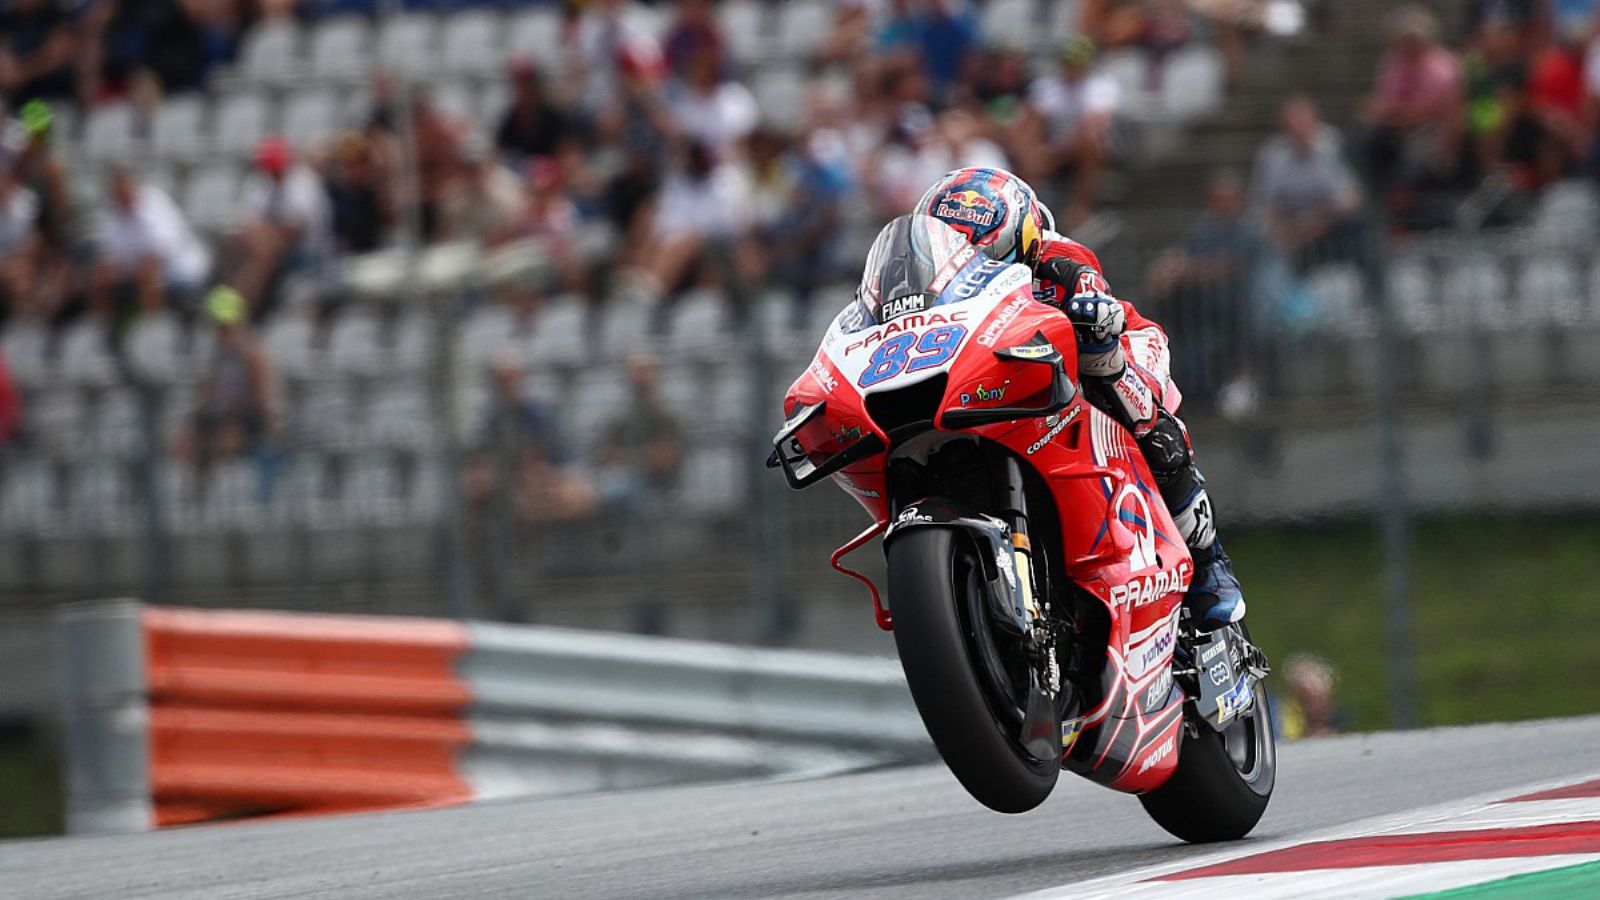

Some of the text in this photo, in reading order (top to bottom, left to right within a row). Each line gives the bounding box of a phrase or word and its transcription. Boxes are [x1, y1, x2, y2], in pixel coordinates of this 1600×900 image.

[937, 204, 994, 226] Red Bull
[953, 259, 1006, 298] OCTO
[882, 293, 926, 321] FIAMM
[983, 295, 1030, 338] PRAMAC
[845, 311, 969, 356] PRAMAC
[857, 323, 968, 389] 89
[1116, 379, 1148, 418] PRAMAC
[1027, 404, 1081, 454] CONFREMAR
[1110, 562, 1190, 613] PRAMAC
[1146, 663, 1174, 708] FIAMM
[1137, 735, 1174, 775] MOTUL
